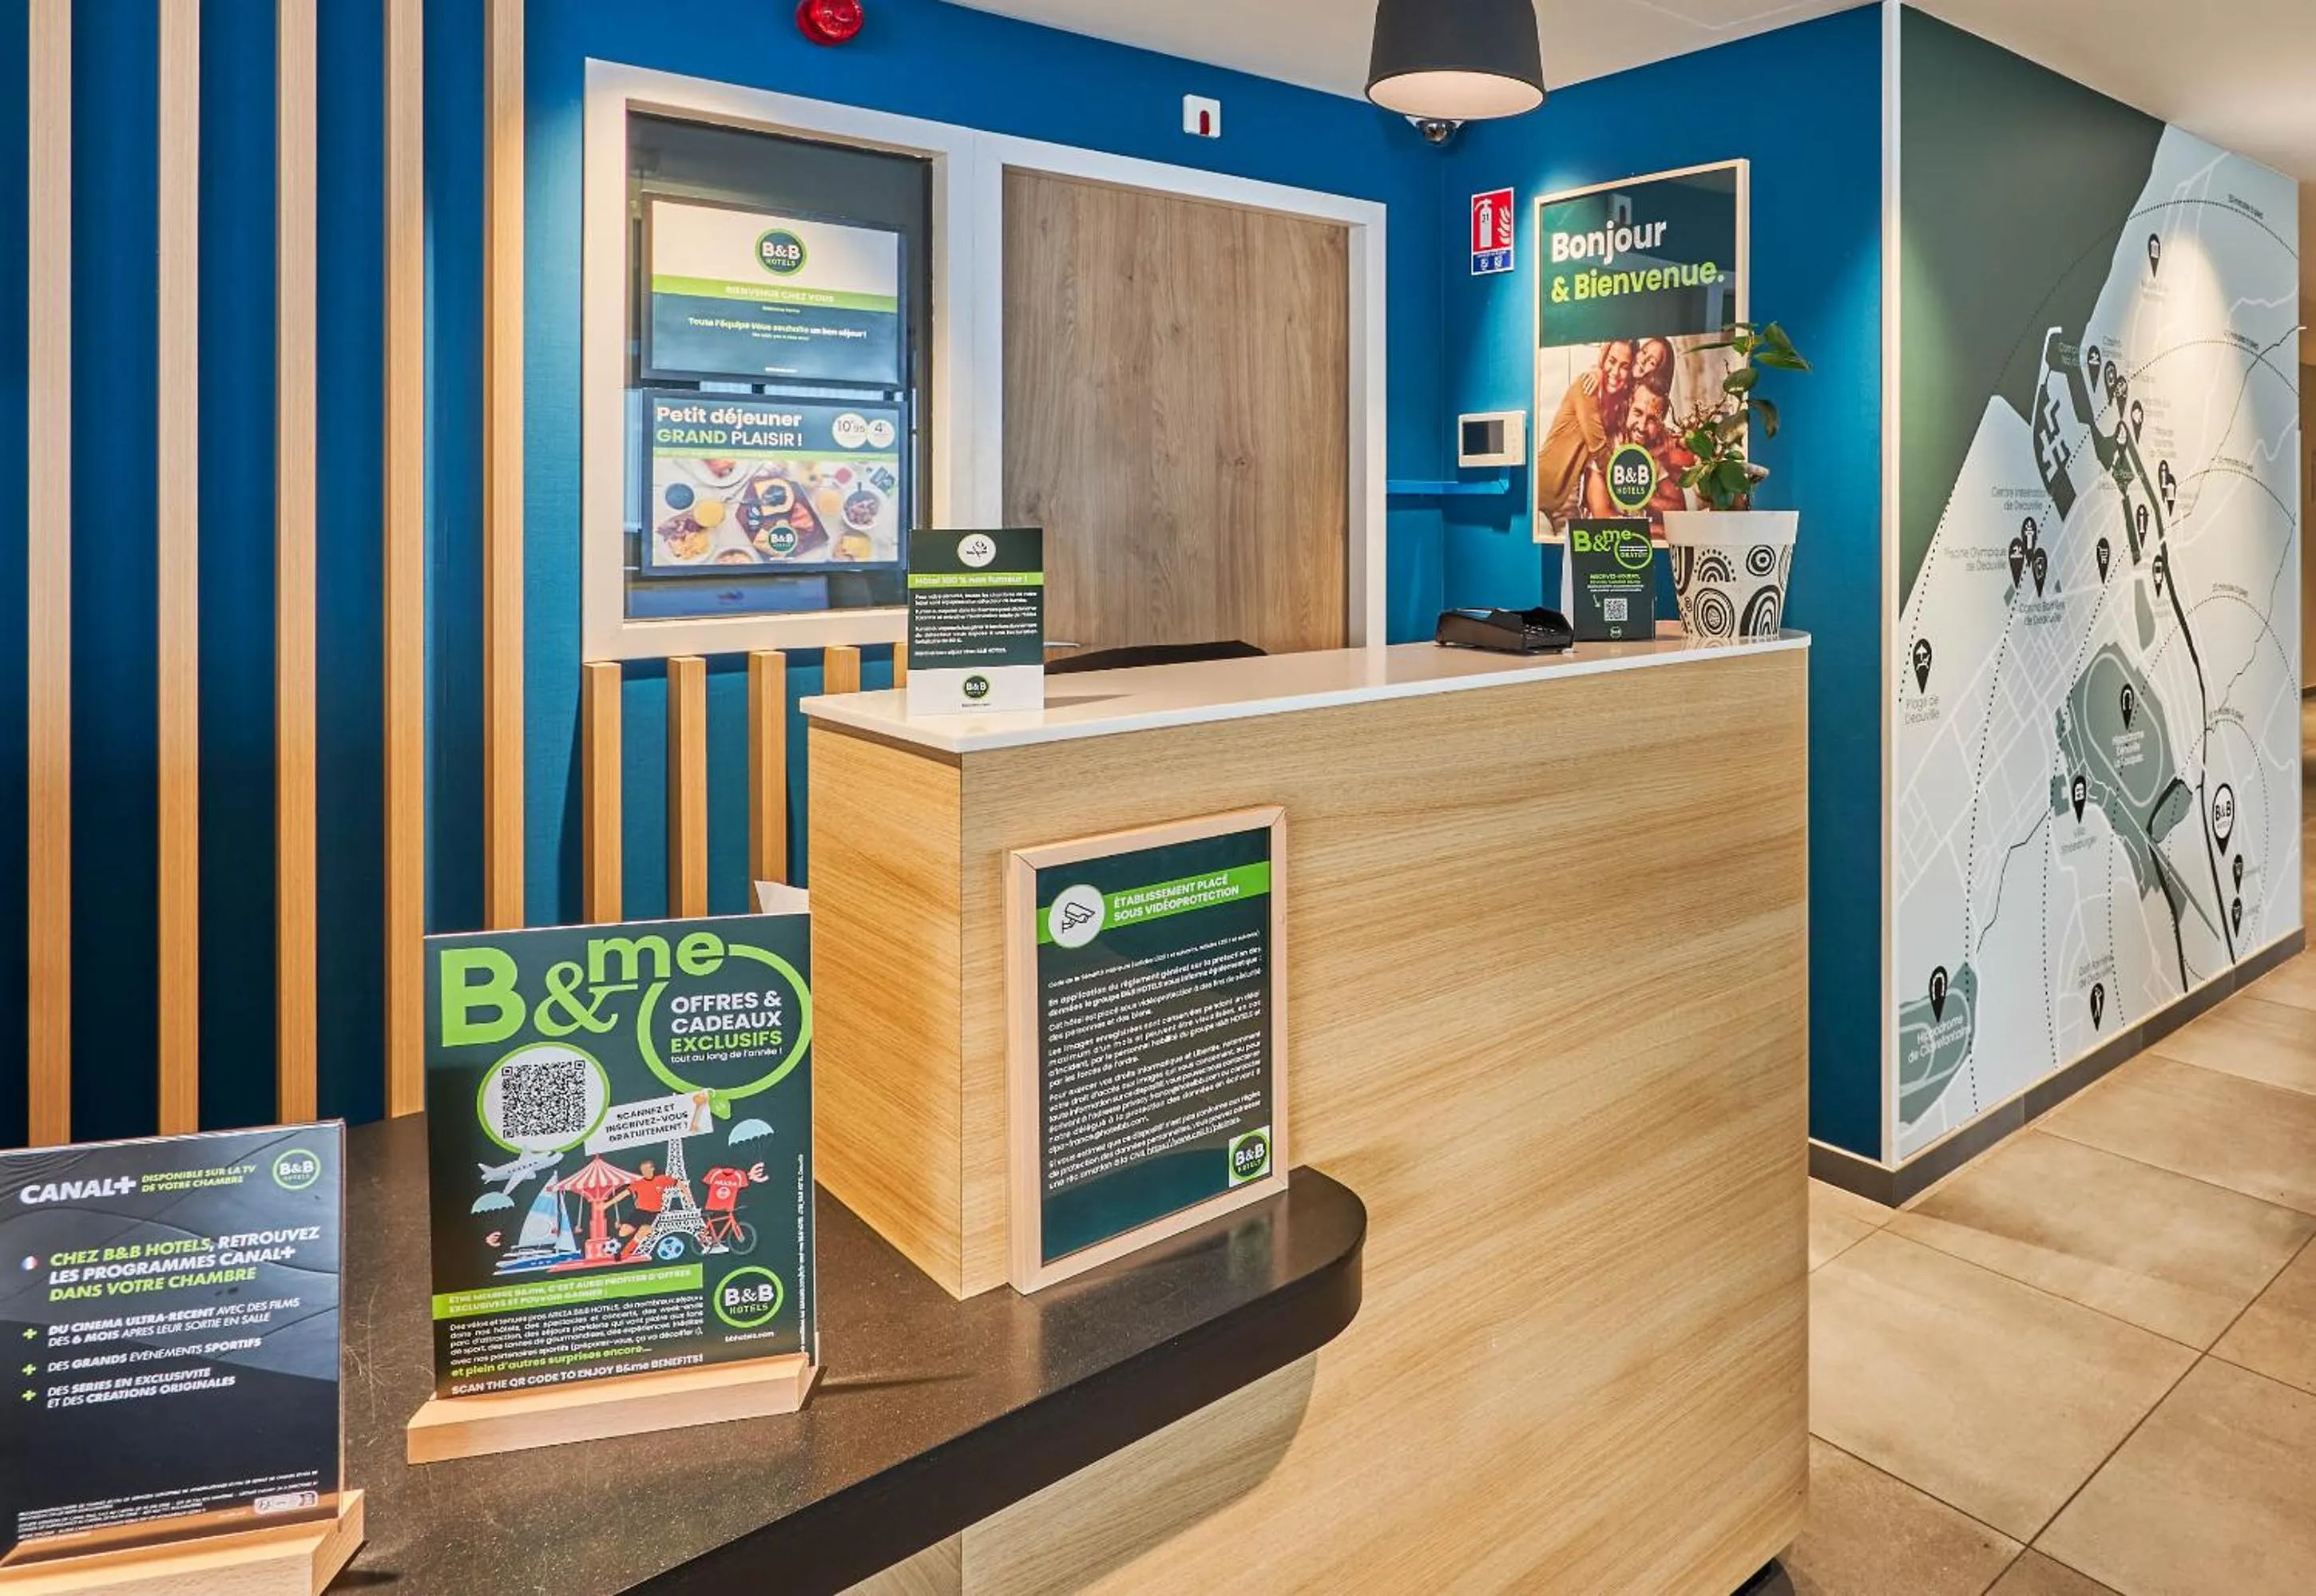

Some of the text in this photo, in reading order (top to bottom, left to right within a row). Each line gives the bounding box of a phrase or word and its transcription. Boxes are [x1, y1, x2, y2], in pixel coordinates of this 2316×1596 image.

[762, 242, 800, 259] B&B
[1552, 220, 1667, 264] Bonjour
[1551, 261, 1724, 303] & Bienvenue.
[656, 406, 802, 429] Petit déjeuner
[656, 429, 727, 444] GRAND
[732, 430, 795, 447] PLAISIR
[1614, 464, 1649, 485] B&B
[1616, 486, 1645, 495] HOTELS
[1114, 873, 1228, 908] ÉTABLISSEMENT PLACÉ
[1114, 885, 1239, 921] SOUS VIDÉOPROTECTION
[671, 990, 782, 1013] OFFRES &
[671, 1011, 782, 1034] CADEAUX
[671, 1030, 782, 1053] EXCLUSIFS
[671, 1053, 691, 1063] tout
[706, 1050, 728, 1061] long
[729, 1049, 742, 1058] de
[744, 1047, 778, 1056] l'année
[605, 1111, 688, 1132] INSCRIVEZ-VOUS
[617, 1106, 661, 1120] SCANNEZ
[609, 1123, 679, 1142] GRATUITEMENT
[1235, 1143, 1265, 1166] B&B
[141, 1164, 256, 1182] DISPONIBLE SUR LA TV
[280, 1160, 314, 1175] B&B
[19, 1175, 136, 1205] CANAL+
[157, 1181, 190, 1190] VOTRE
[192, 1175, 243, 1187] CHAMBRE
[50, 1226, 319, 1267] CHEZ B&B HOTELS, RETROUVEZ
[48, 1245, 295, 1285] LES PROGRAMMES CANAL+
[48, 1265, 256, 1301] DANS VOTRE CHAMBRE
[725, 1284, 774, 1306] B&B
[48, 1297, 300, 1336] DU CINEMA ULTRA-RECENT AVEC DES FILMS
[729, 1303, 768, 1314] HOTELS
[48, 1311, 270, 1348] DES 6 MOIS APRES LEUR SORTIE EN SALLE
[47, 1337, 262, 1372] DES GRANDS EVENEMENTS SPORTIFS
[451, 1367, 463, 1376] et
[466, 1364, 495, 1376] plein
[497, 1359, 545, 1370] d'autres
[548, 1352, 601, 1364] surprises
[47, 1367, 210, 1397] DES SERIES EN EXCLUSIVITE
[451, 1353, 703, 1394] SCAN THE QR CODE TO ENJOY B&me BENEFITS!
[47, 1376, 235, 1409] ET DES CREATIONS ORIGINALES
